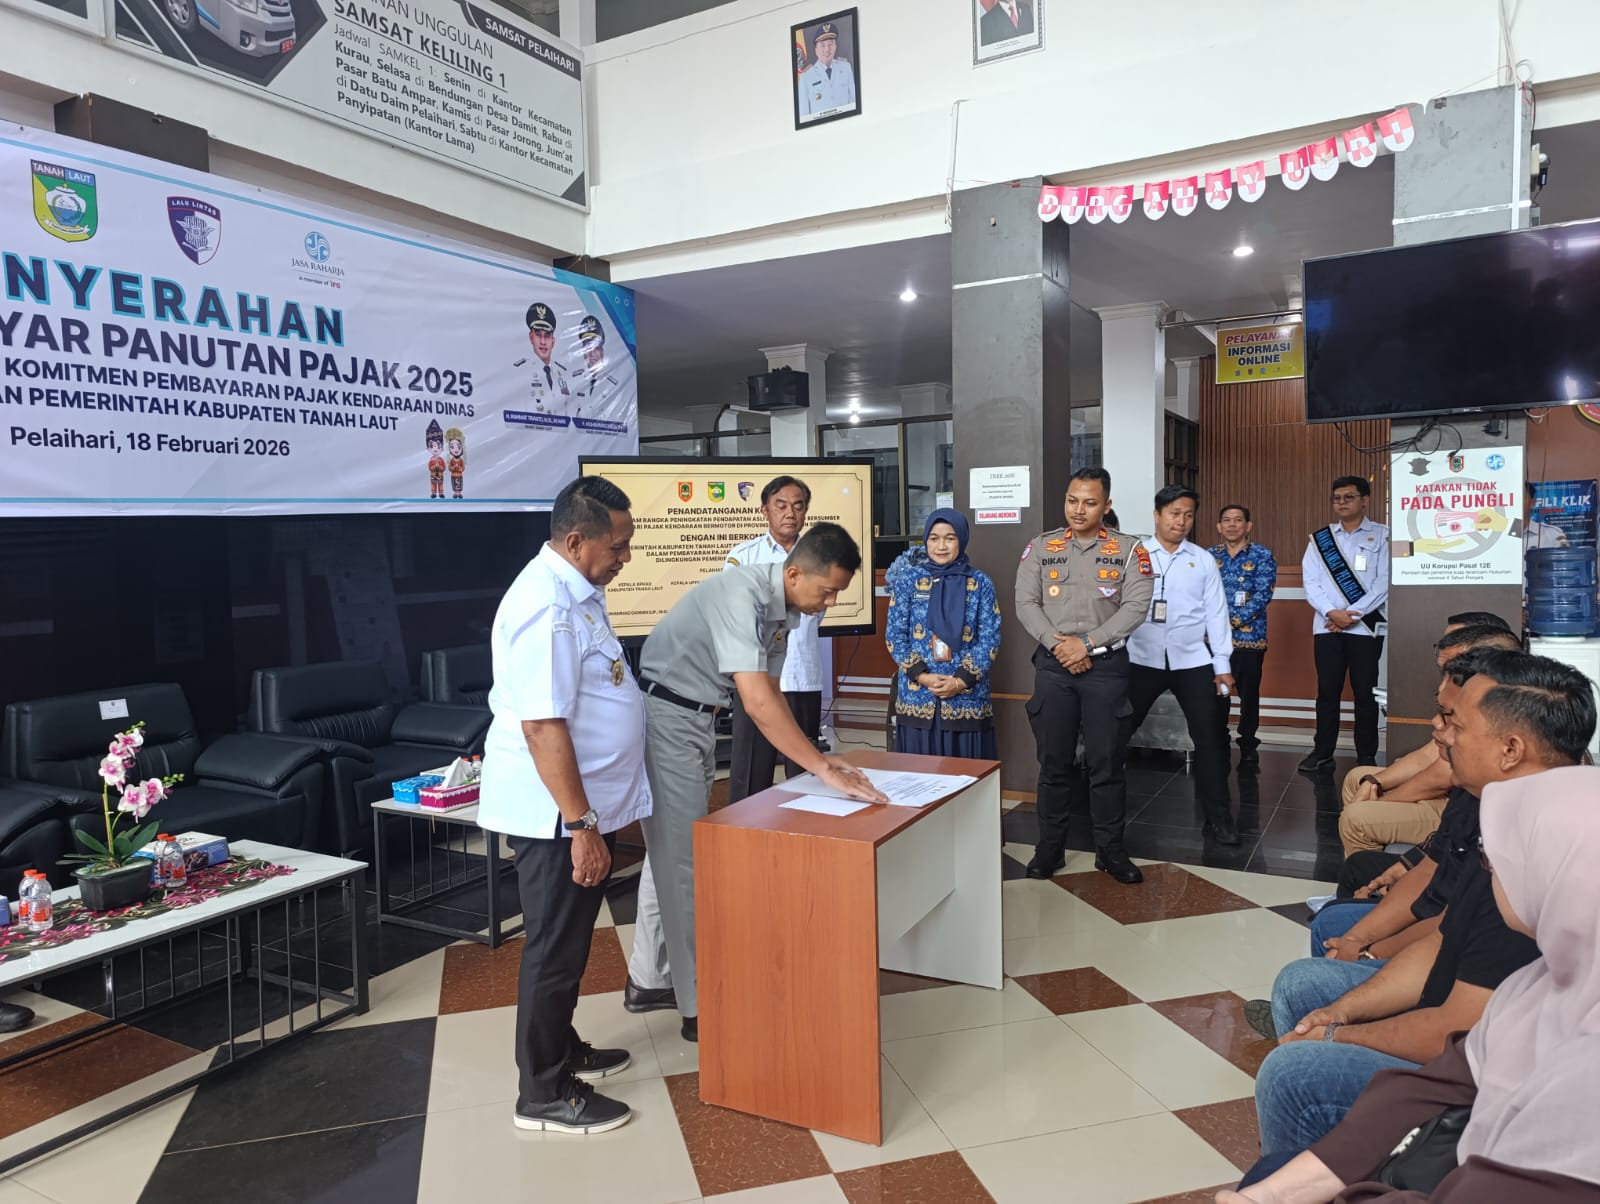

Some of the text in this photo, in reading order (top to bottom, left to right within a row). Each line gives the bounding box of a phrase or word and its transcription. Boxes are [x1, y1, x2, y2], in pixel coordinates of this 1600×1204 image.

[414, 8, 493, 59] UNGGULAN
[334, 0, 506, 88] SAMSAT KELILING 1
[485, 18, 575, 72] SAMSAT PELAIHARI
[334, 24, 371, 48] Jadwal
[379, 43, 421, 71] SAMKEL
[444, 72, 471, 92] Senin
[477, 88, 486, 98] di
[493, 93, 522, 114] Kantor
[528, 109, 572, 136] Kecamatan
[336, 40, 573, 149] Kurau, Selasa di Bendungan Desa Damit, Rabu di
[336, 57, 367, 79] Pasar
[372, 72, 397, 91] Batu
[401, 85, 439, 109] Ampar,
[442, 101, 471, 121] Kamis
[474, 115, 482, 126] di
[486, 119, 510, 137] Pasar
[513, 131, 543, 152] Jorong,
[336, 75, 573, 177] di Datu Daim Pelaihari, Sabtu di Kantor Kecamatan
[338, 91, 475, 154] Panyipatan (Kantor Lama)
[32, 162, 91, 184] TANAH LAUT
[192, 201, 217, 216] LINTAS
[292, 258, 345, 276] JASA RAHARJA
[304, 277, 323, 285] member
[102, 323, 291, 377] PANUTAN
[299, 349, 401, 390] PAJAK
[408, 364, 474, 397] 2025
[1228, 343, 1291, 357] INFORMASI
[1238, 354, 1280, 366] ONLINE
[5, 357, 475, 418] KOMITMEN PEMBAYARAN PAJAK KENDARAAN DINAS
[0, 385, 398, 431] N PEMERINTAH KABUPATEN TANAH LAUT
[10, 426, 290, 456] Pelaihari, 18 Februari 2026
[1415, 481, 1497, 494] KATAKAN TIDAK
[1401, 493, 1514, 511] PADA PUNGLI
[1561, 494, 1592, 506] KLIK
[668, 507, 753, 515] PENANDATANGANAN
[680, 533, 766, 542] DENGAN INI BERKOM
[1041, 556, 1068, 566] DIKAV
[1095, 557, 1124, 567] POLRI
[1432, 562, 1458, 570] Korupsi
